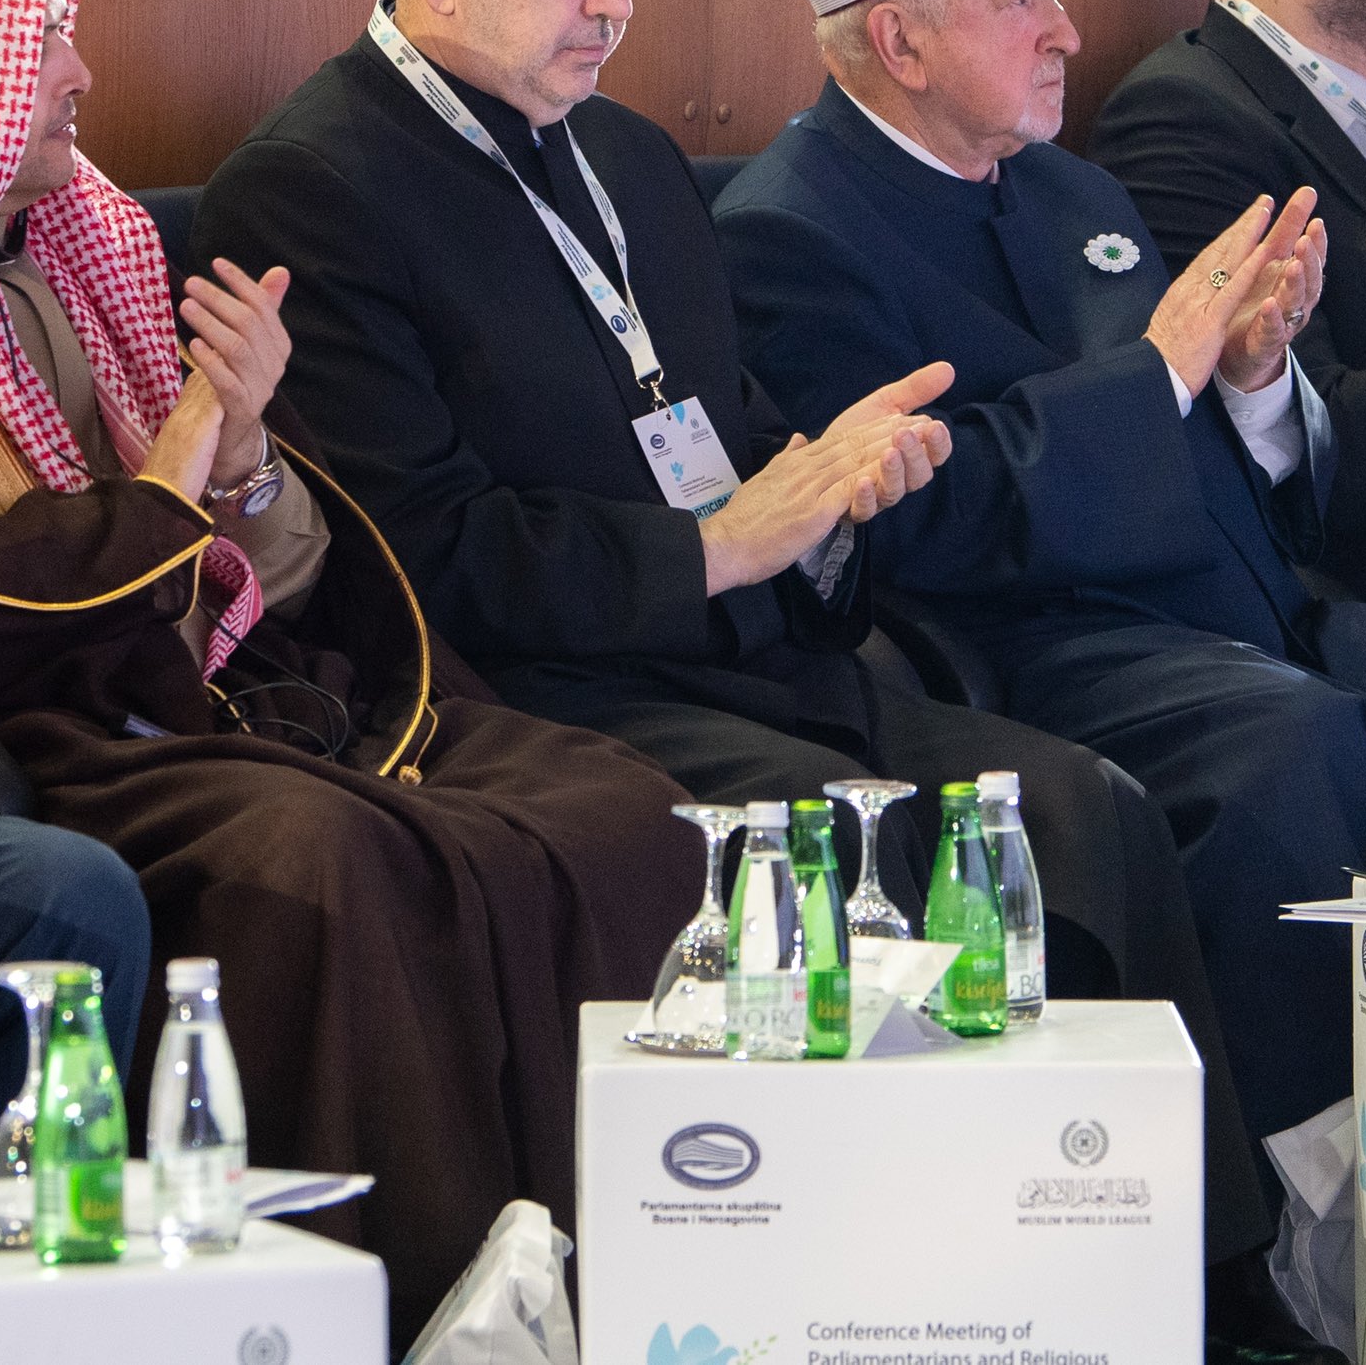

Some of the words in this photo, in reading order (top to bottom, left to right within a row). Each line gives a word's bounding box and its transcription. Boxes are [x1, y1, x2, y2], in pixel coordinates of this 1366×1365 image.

[807, 1322, 921, 1341] Conference
[926, 1322, 1007, 1344] Meeting
[1013, 1321, 1033, 1340] of
[808, 1351, 971, 1365] Parliamentarians
[977, 1350, 1015, 1365] and
[1021, 1349, 1108, 1365] Religious
